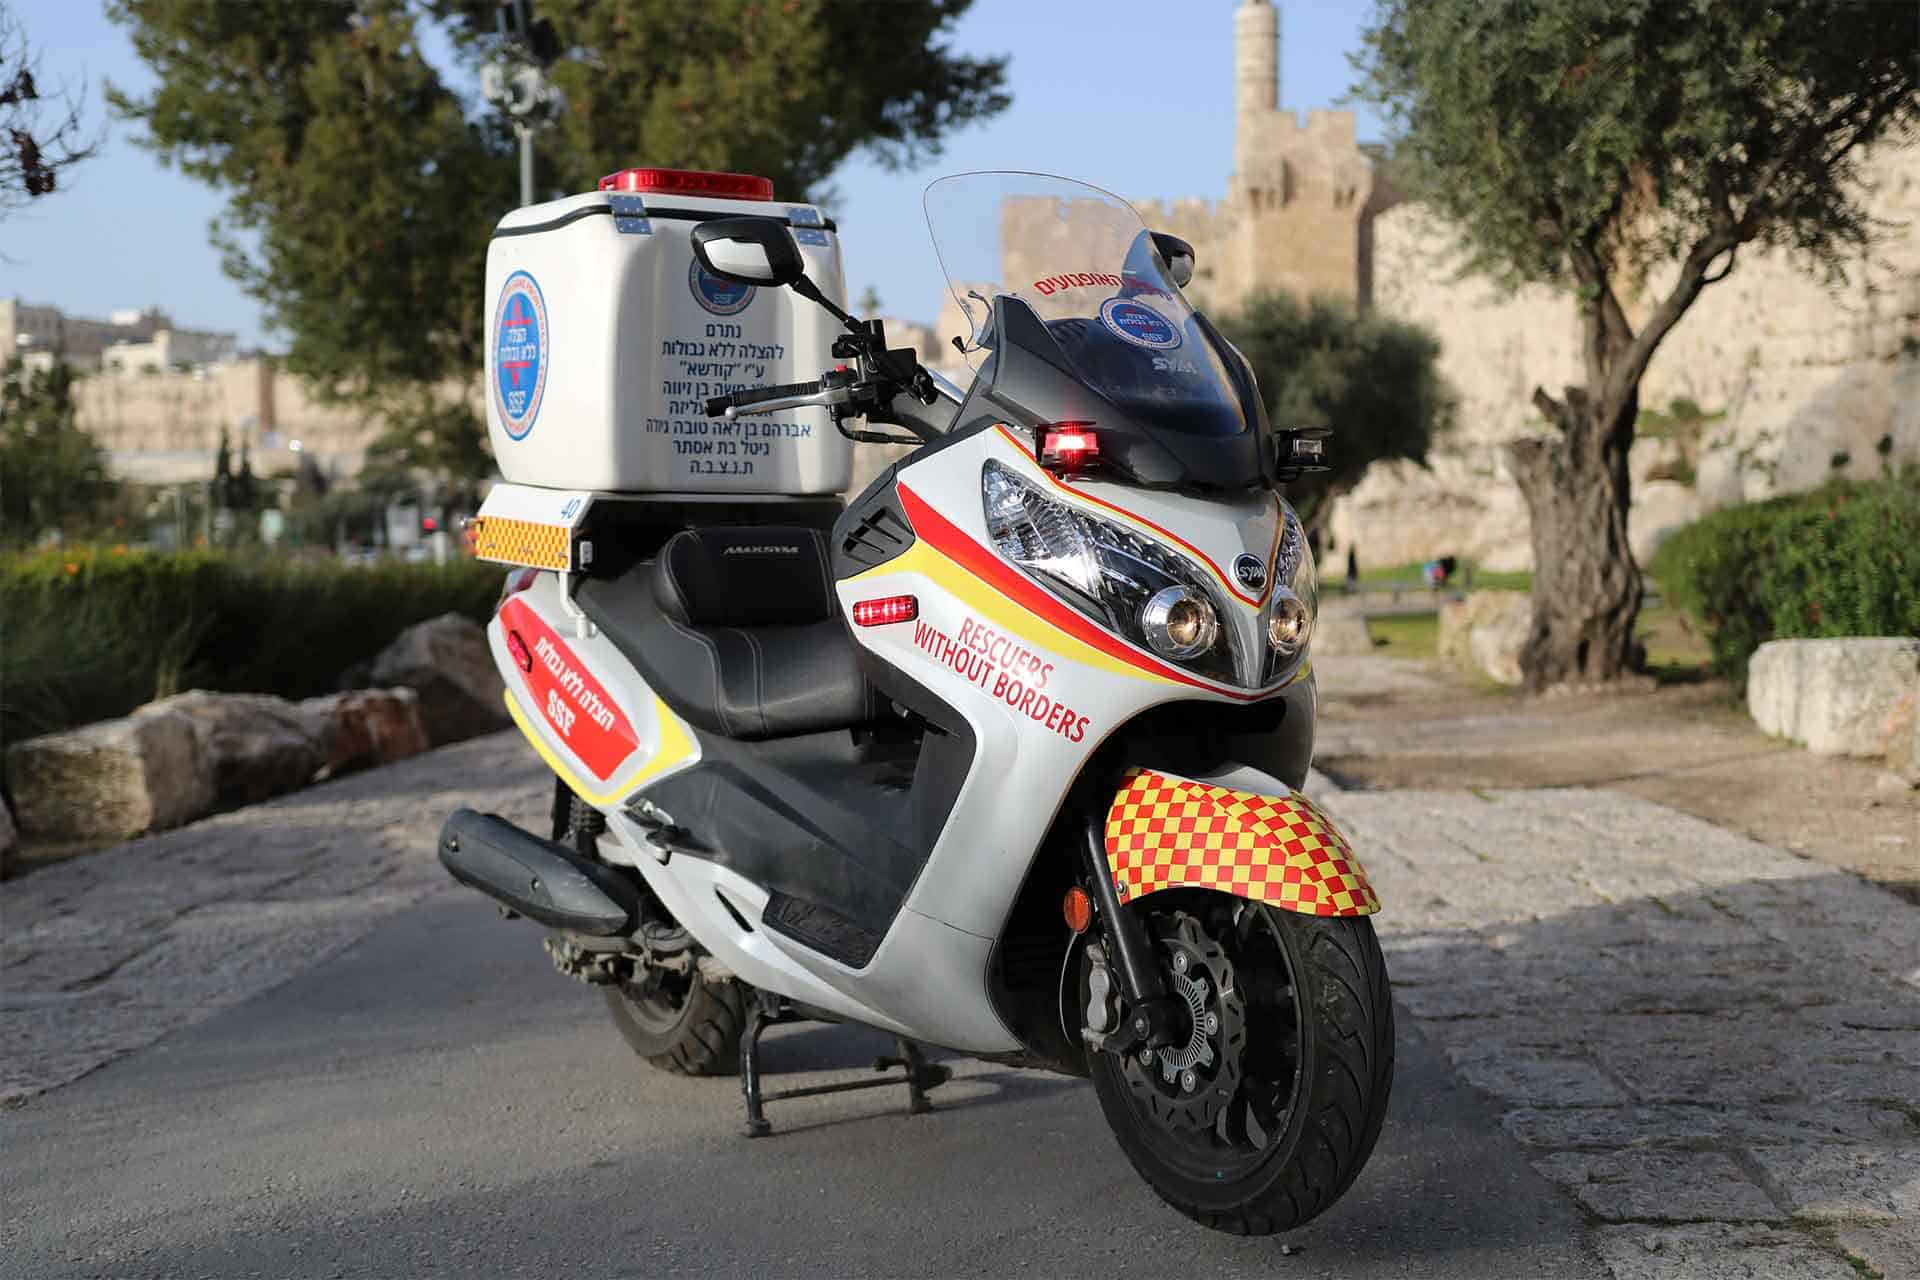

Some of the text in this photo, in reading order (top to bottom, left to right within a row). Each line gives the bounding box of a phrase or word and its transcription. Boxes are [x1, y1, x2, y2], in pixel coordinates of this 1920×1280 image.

[706, 323, 742, 338] נתרם
[661, 340, 785, 360] להצלה ללא גבולות
[695, 381, 709, 400] בן
[673, 419, 708, 435] טובה
[712, 420, 742, 435] לאה
[745, 422, 758, 440] בן
[762, 423, 811, 438] אברהם
[672, 439, 714, 455] אסתר
[717, 440, 737, 455] בת
[560, 498, 581, 521] 40
[1239, 565, 1266, 582] SYM
[958, 616, 1054, 689] RESCUERS
[914, 618, 1091, 743] WITHOUT BORDERS
[547, 689, 577, 737] SSF
